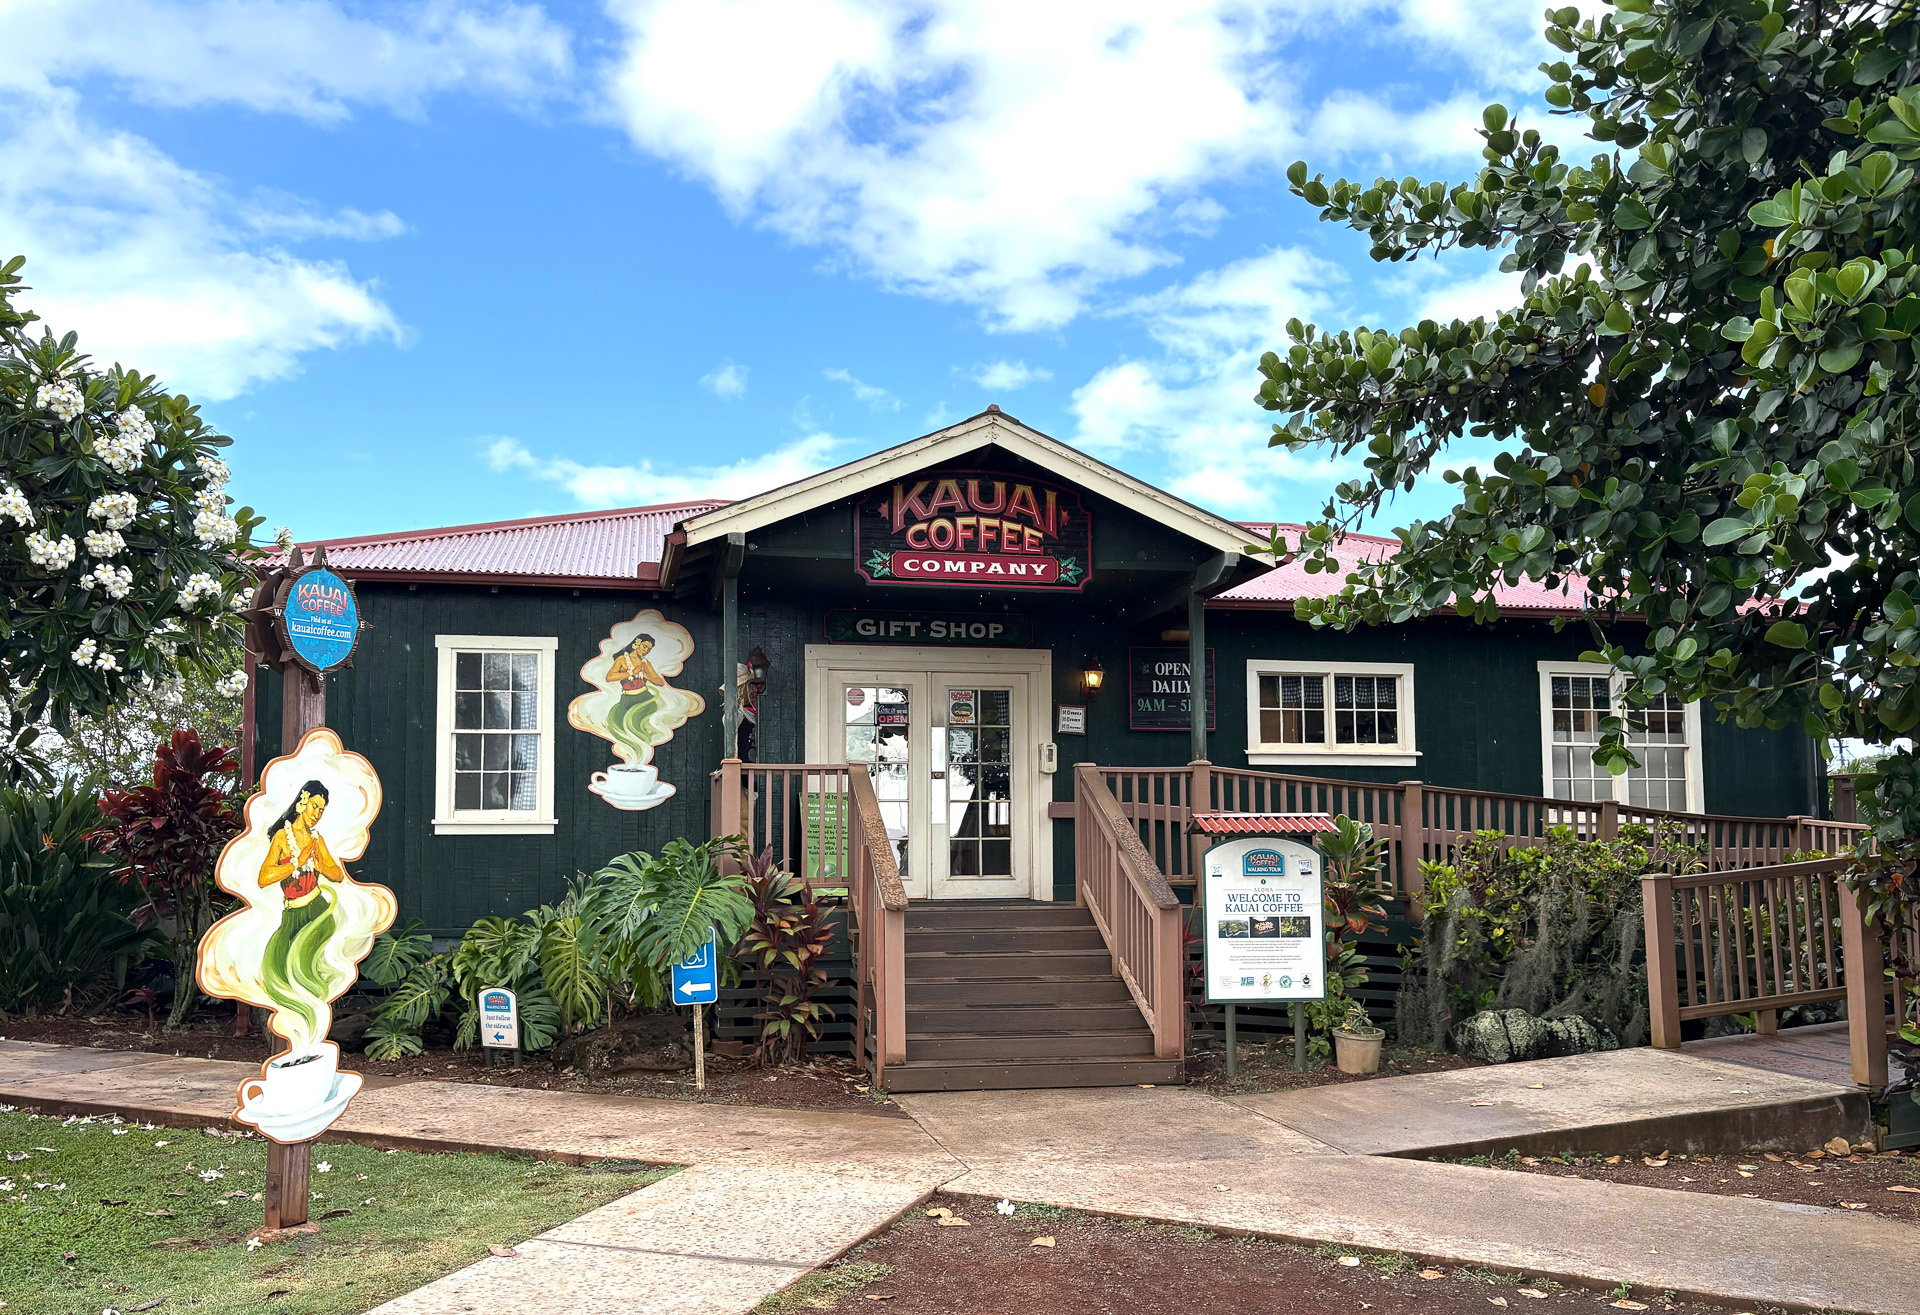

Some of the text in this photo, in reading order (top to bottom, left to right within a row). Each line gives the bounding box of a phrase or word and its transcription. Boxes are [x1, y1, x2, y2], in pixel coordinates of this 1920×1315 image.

[891, 478, 1059, 540] KAUAI
[905, 515, 1045, 555] COFFEE
[903, 559, 1049, 576] COMPANY
[298, 584, 348, 610] KAUAI
[302, 598, 344, 616] COFFEE
[292, 621, 351, 638] kauaicoffee.com
[856, 618, 1004, 638] GIFT SHOP
[1155, 662, 1190, 676] OPEN
[1152, 680, 1191, 693] DAILY
[1137, 699, 1165, 711] 9AM
[1250, 854, 1278, 863] KAUAI
[1227, 893, 1301, 902] WELCOME TO
[1225, 903, 1303, 912] KAUAI COFFEE
